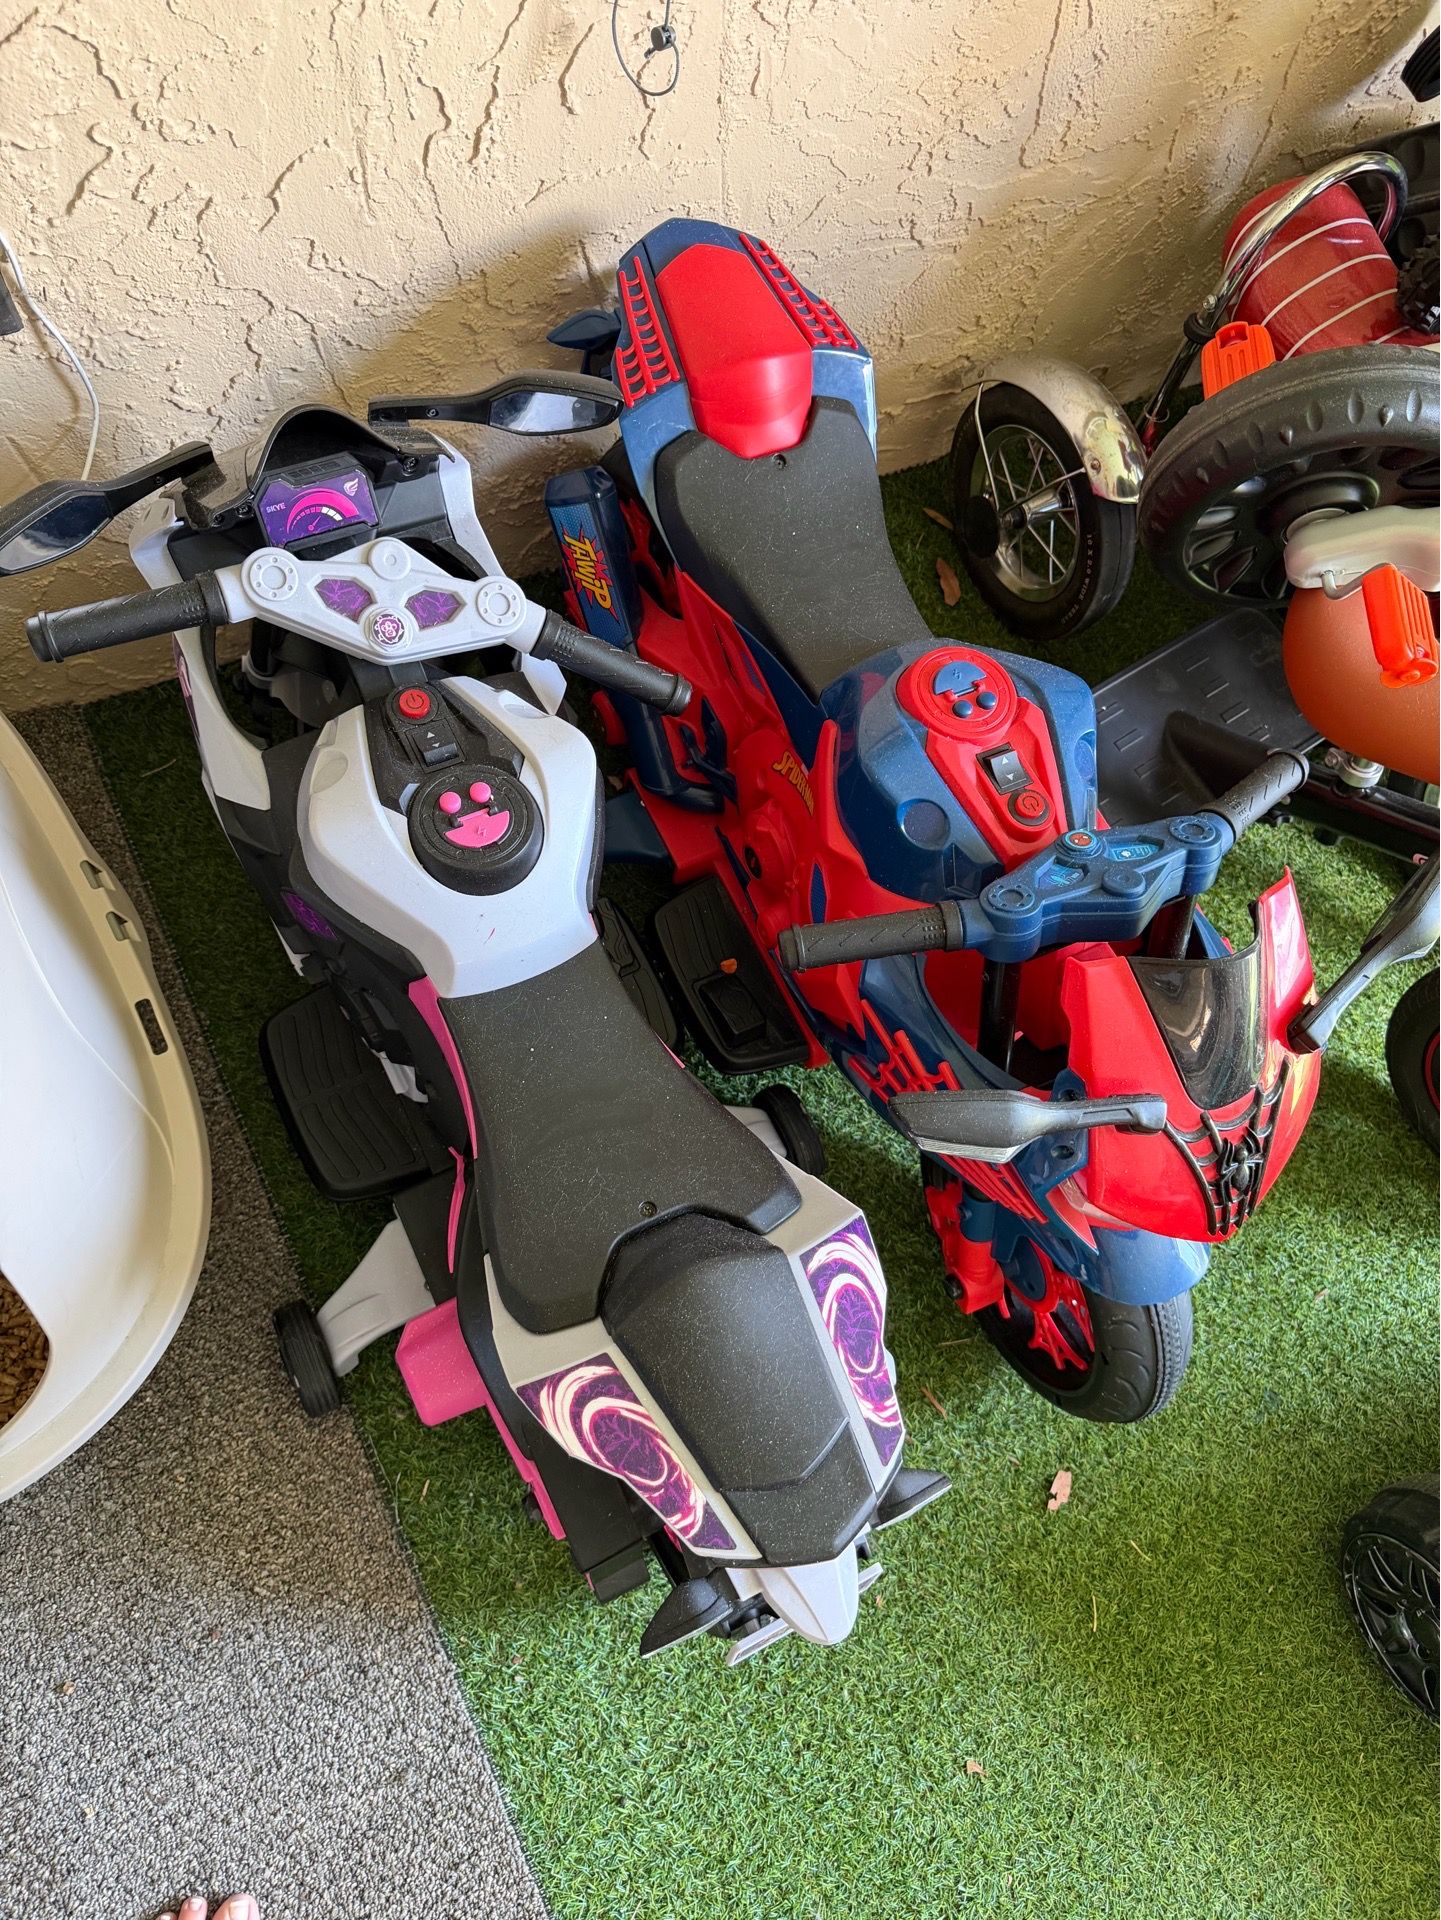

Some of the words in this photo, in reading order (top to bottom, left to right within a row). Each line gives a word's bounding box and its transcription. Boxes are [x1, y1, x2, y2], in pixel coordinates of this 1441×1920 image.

[266, 502, 287, 513] SKYE
[1086, 534, 1094, 545] 10
[1078, 578, 1090, 601] WIDE
